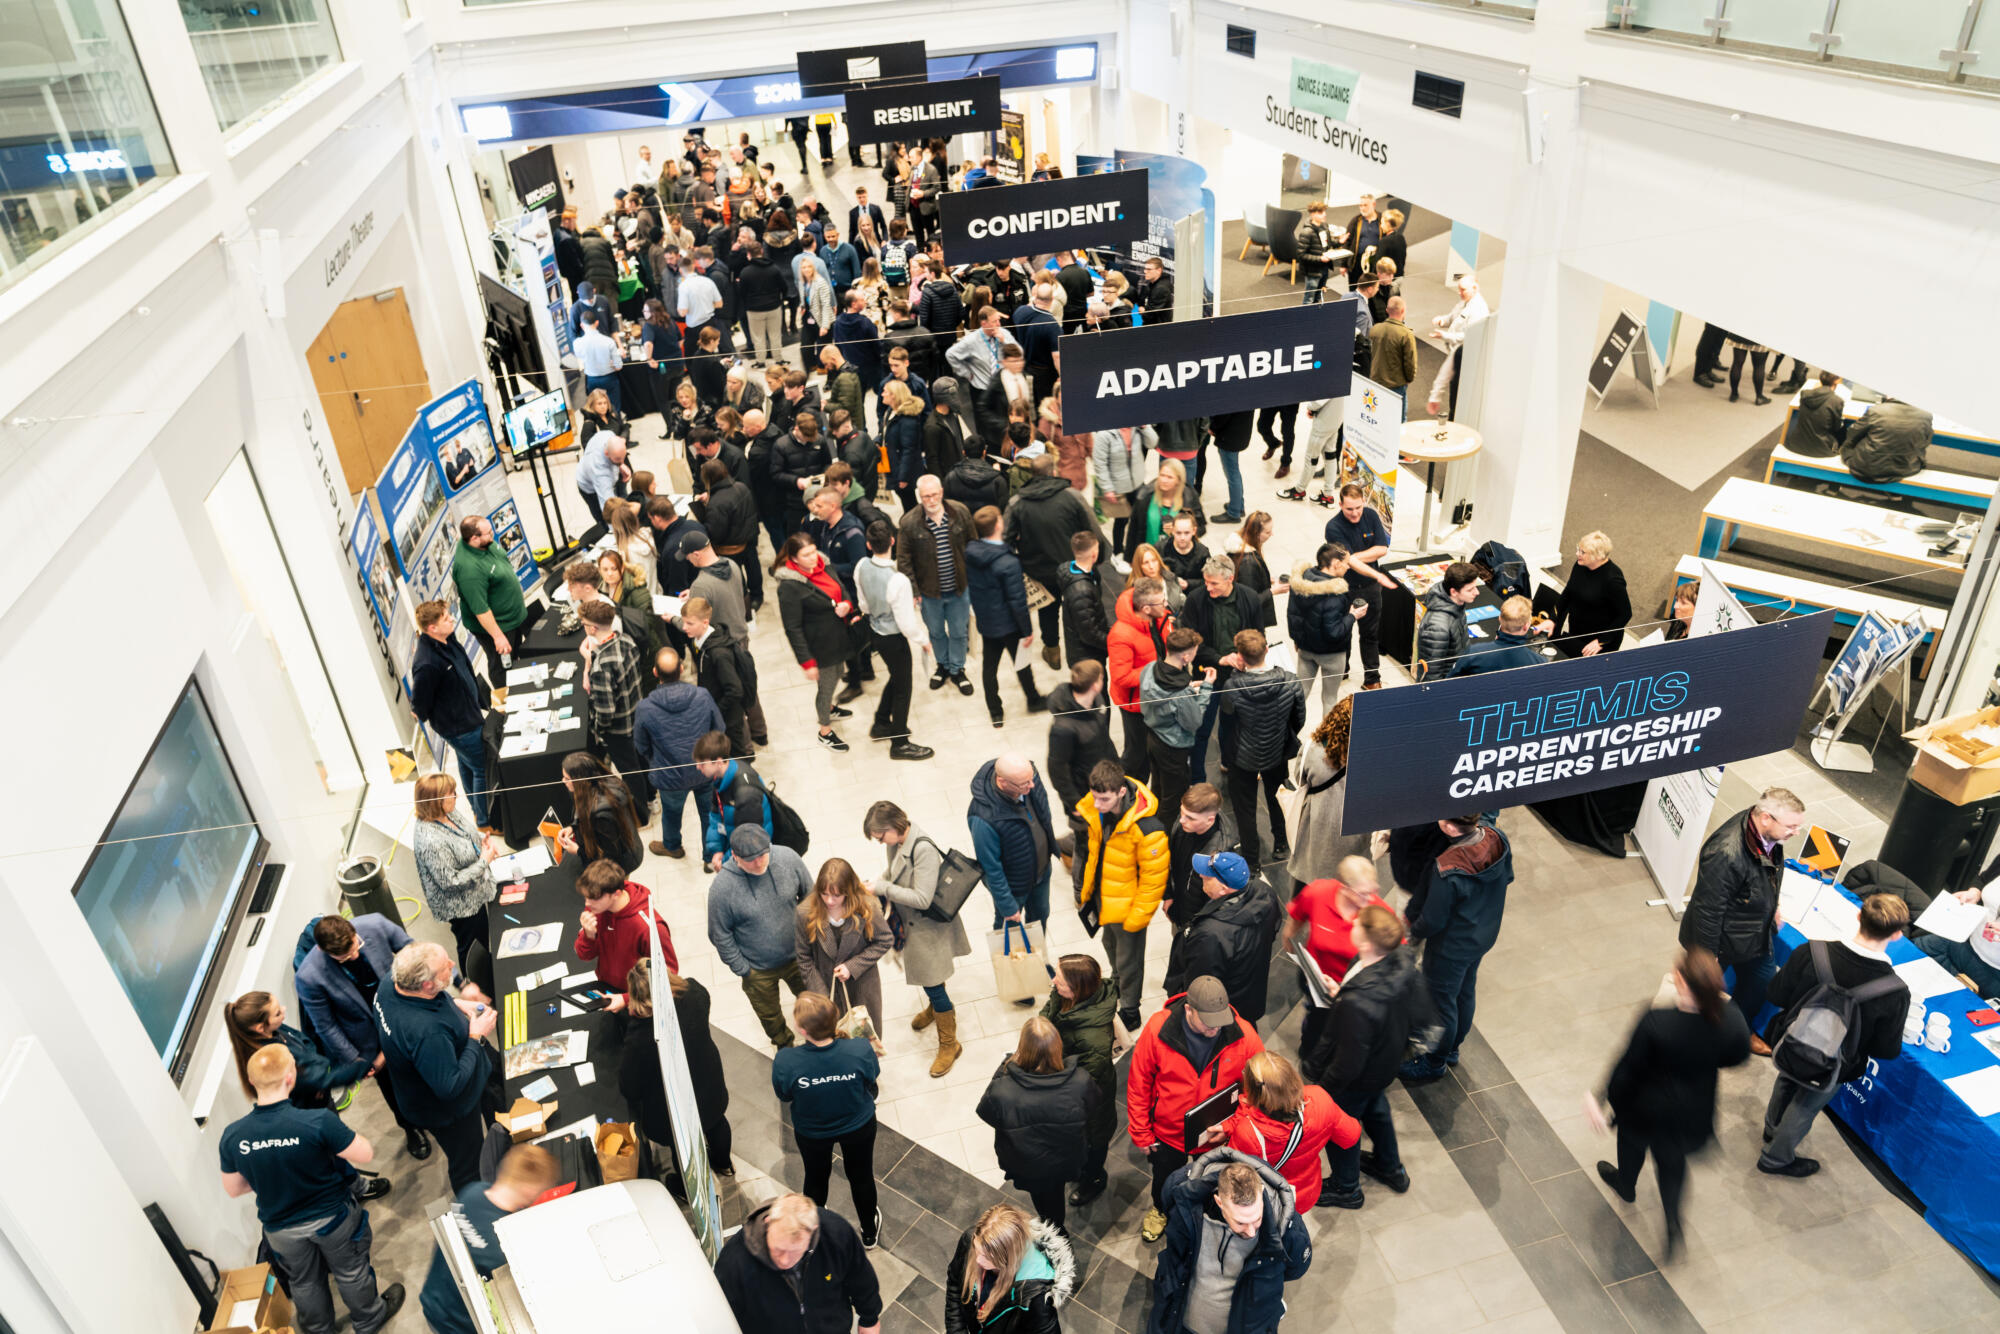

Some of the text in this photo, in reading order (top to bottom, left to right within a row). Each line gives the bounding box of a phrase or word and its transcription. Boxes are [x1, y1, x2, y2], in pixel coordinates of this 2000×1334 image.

[753, 82, 801, 104] ZON
[1297, 76, 1316, 95] ADVICE
[1321, 82, 1350, 104] GUIDANCE
[873, 100, 976, 126] RESILIENT.
[1265, 95, 1388, 164] Student Services
[967, 200, 1125, 239] CONFIDENT.
[325, 211, 374, 288] Lecture Theatre
[1095, 344, 1322, 398] ADAPTABLE.
[1360, 412, 1378, 425] ESP
[1458, 671, 1690, 747] THEMIS
[1451, 706, 1722, 775] APPRENTICESHIP
[1448, 733, 1701, 799] CAREERS EVENT.
[811, 1072, 856, 1085] SAFRAN
[251, 1136, 300, 1151] SAFRAN
